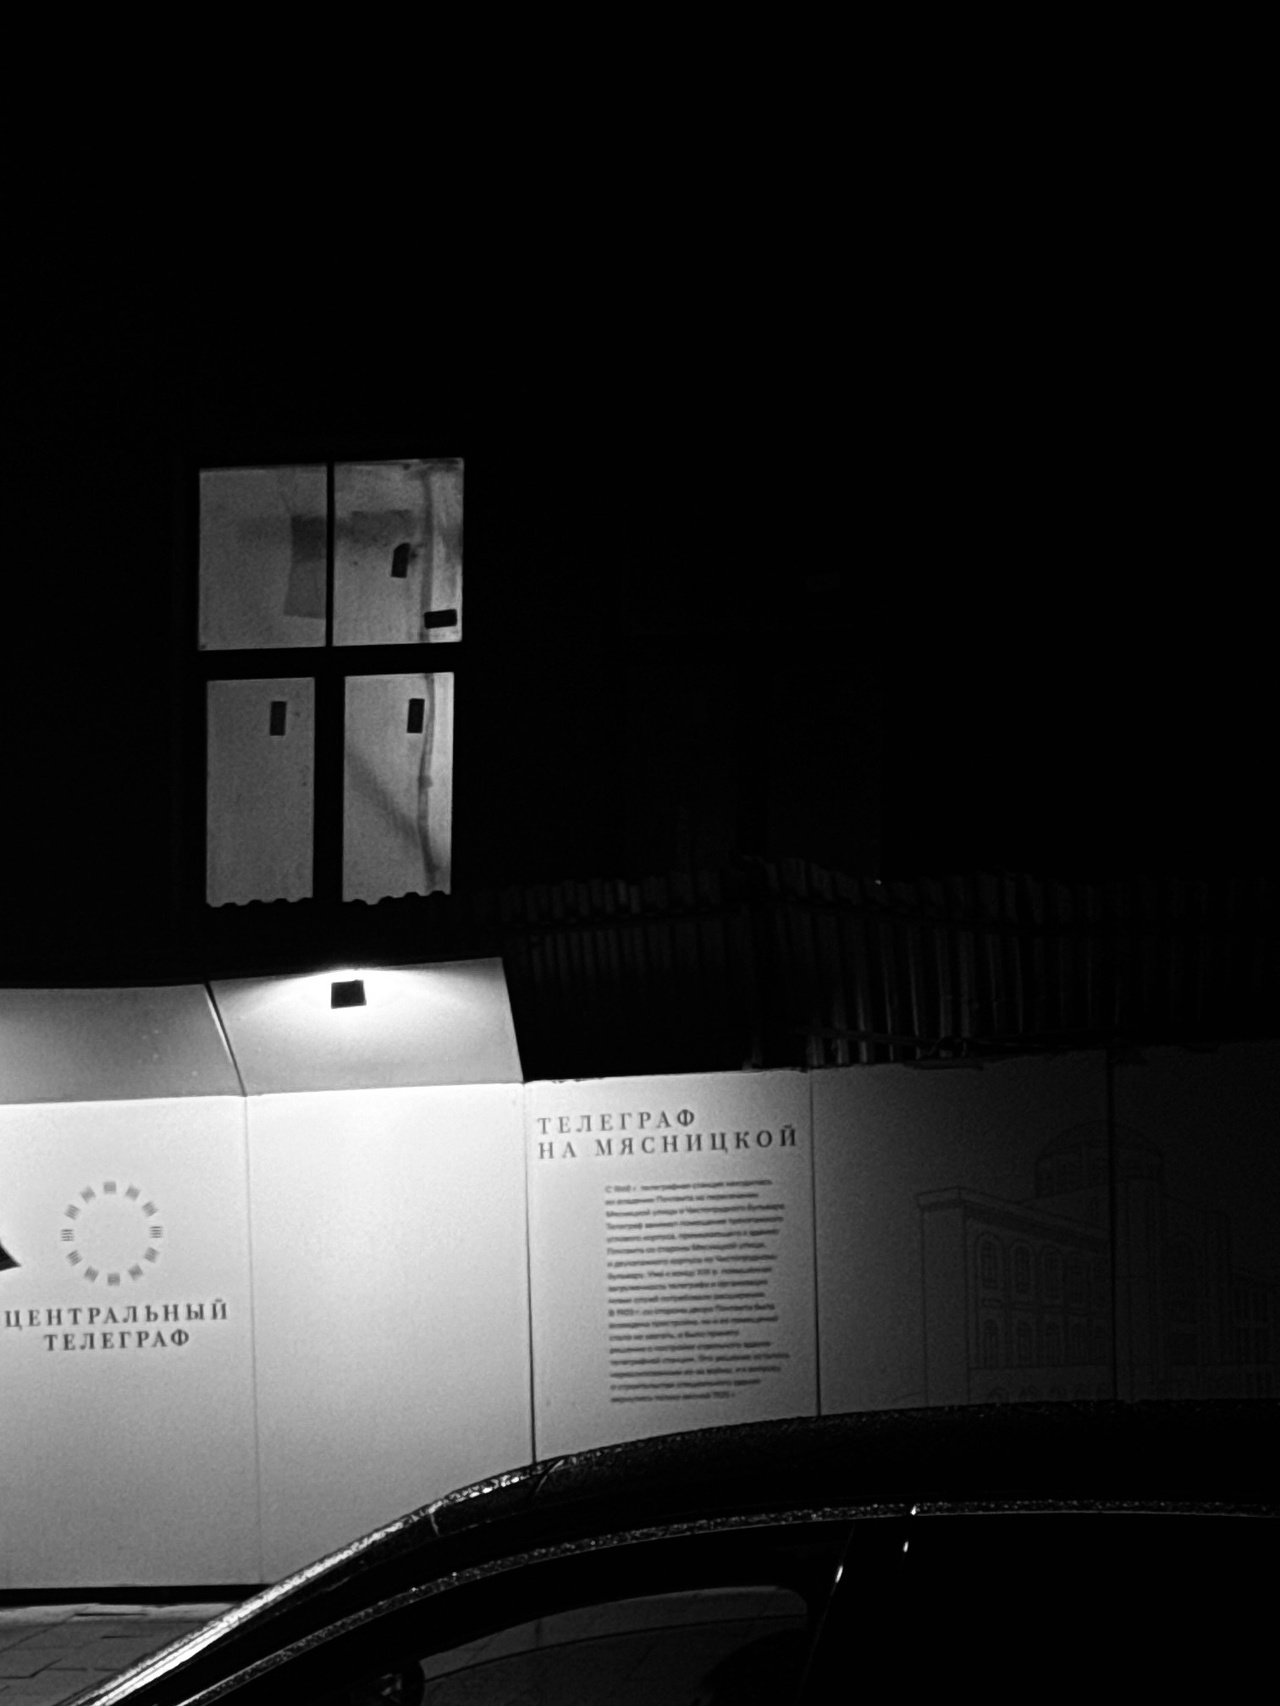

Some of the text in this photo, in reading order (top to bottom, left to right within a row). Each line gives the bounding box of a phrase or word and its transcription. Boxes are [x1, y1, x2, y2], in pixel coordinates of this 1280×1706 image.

[537, 1108, 696, 1135] ТЕЛЕГРАФ
[538, 1123, 797, 1160] НА МЯСНИЦКОЙ
[4, 1298, 228, 1331] ЦЕНТРАЛЬНЫЙ
[43, 1328, 190, 1351] ТЕЛЕГРАФ
